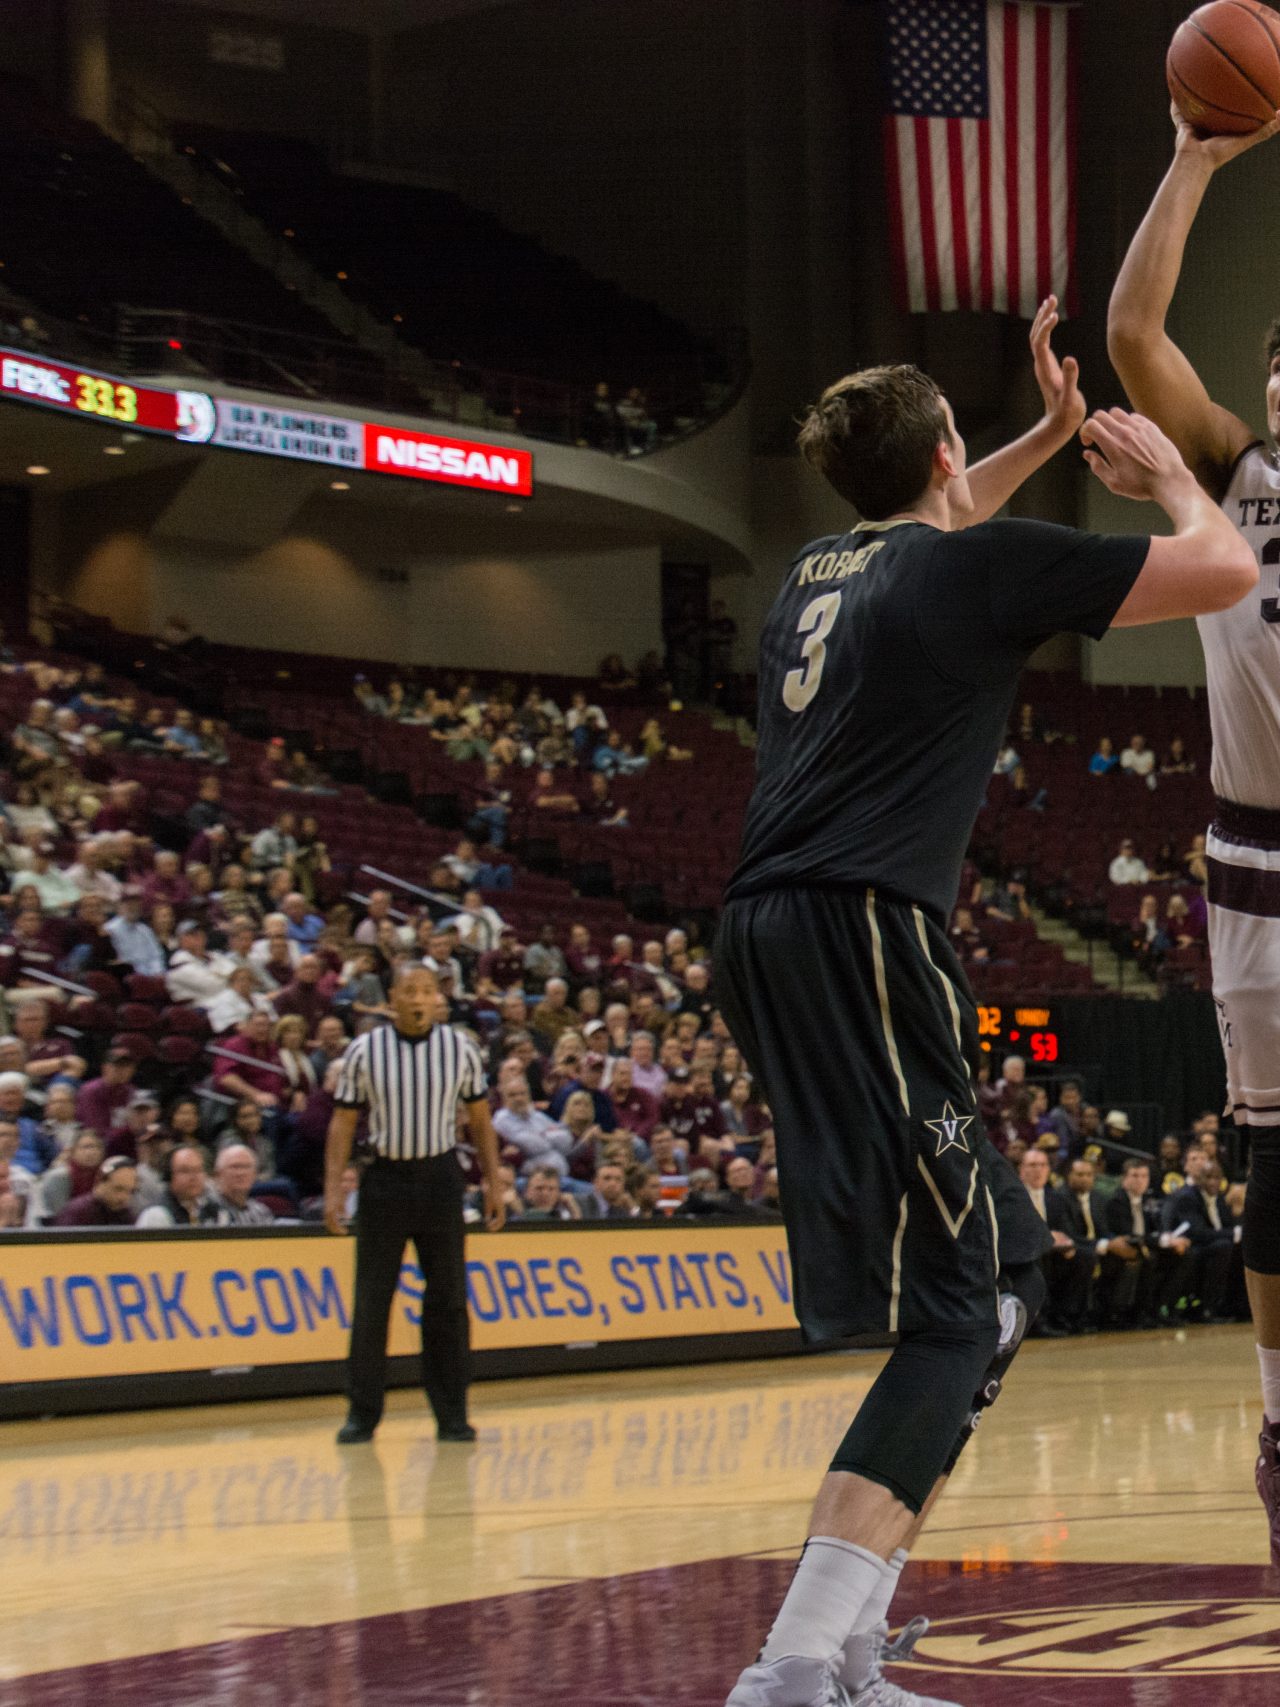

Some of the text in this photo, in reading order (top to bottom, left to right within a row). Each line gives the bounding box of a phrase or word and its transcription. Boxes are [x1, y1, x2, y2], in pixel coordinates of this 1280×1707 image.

[377, 435, 518, 486] NISSAN
[783, 590, 842, 712] 3
[942, 1120, 958, 1141] V
[396, 1257, 610, 1327] SORES,
[610, 1251, 765, 1317] STATS,
